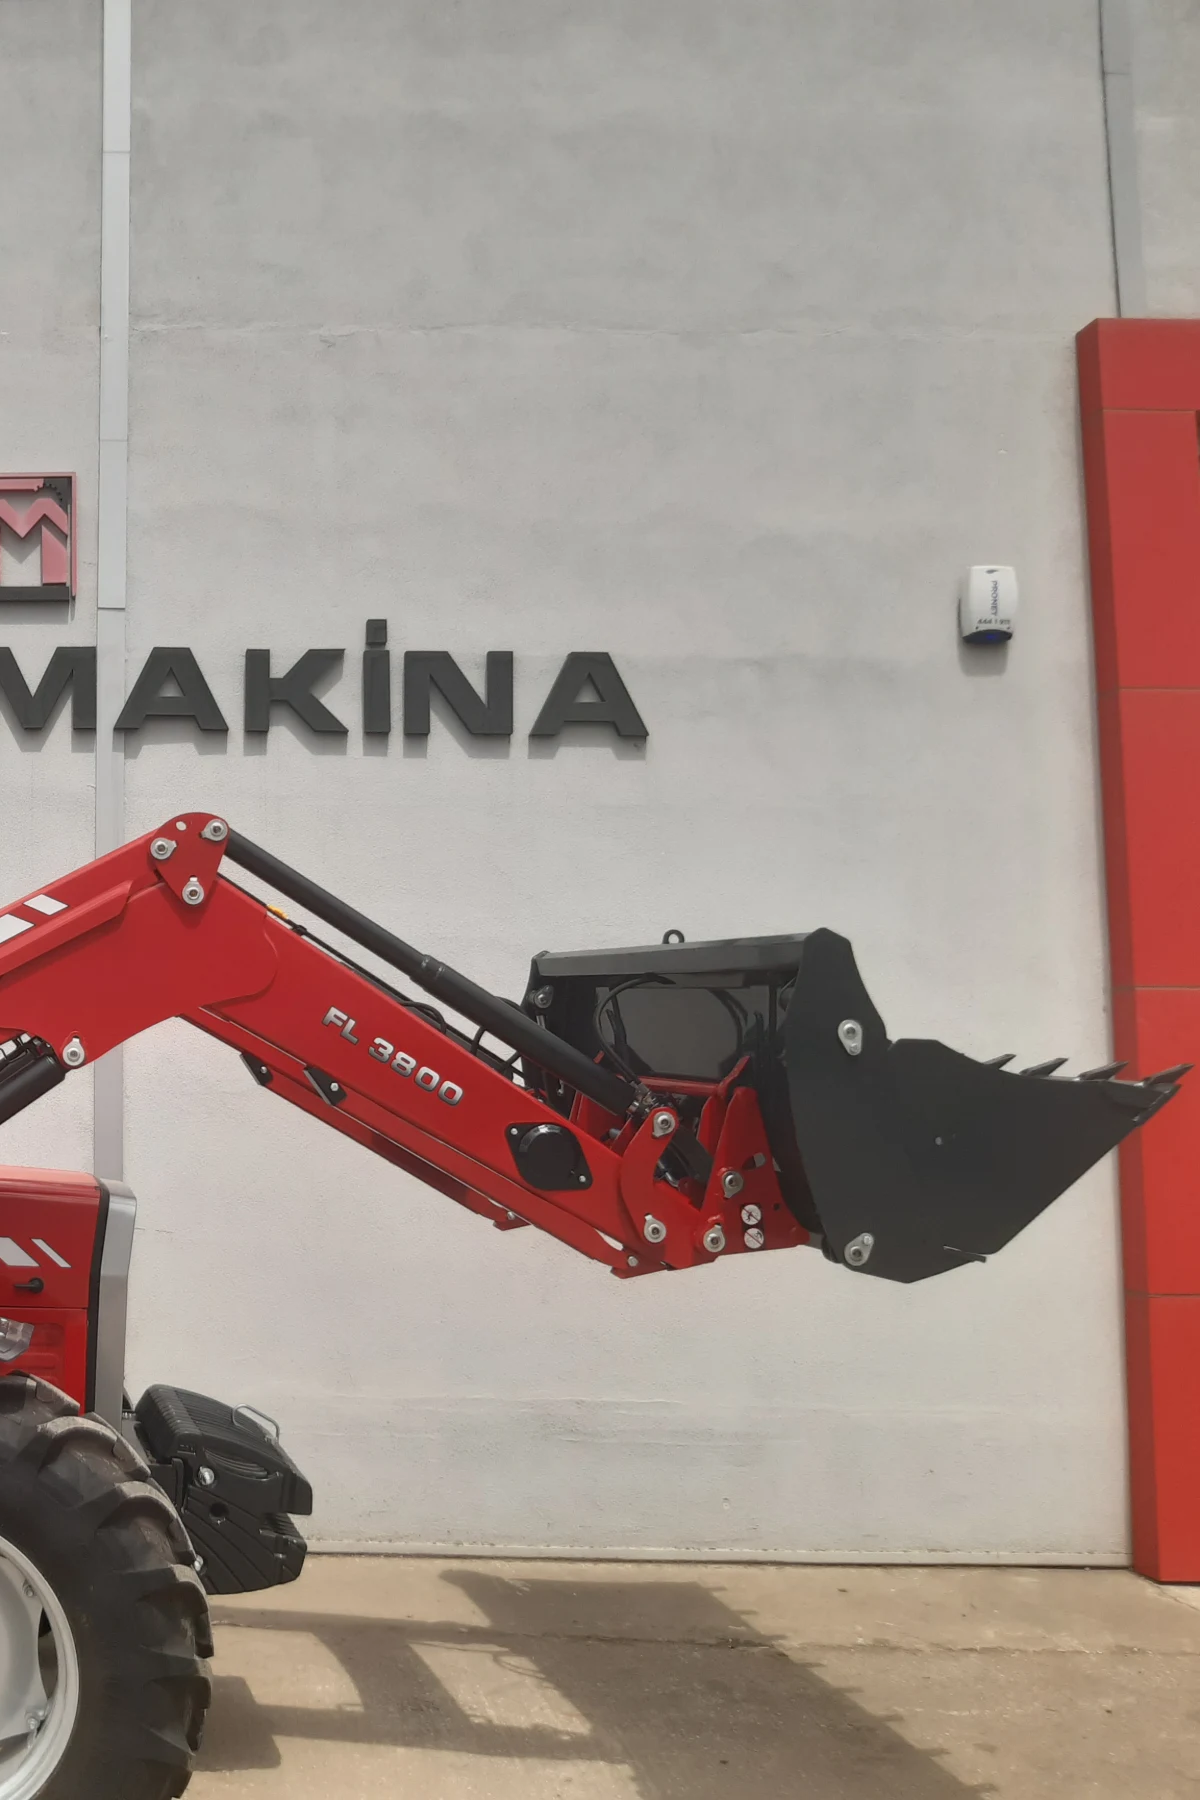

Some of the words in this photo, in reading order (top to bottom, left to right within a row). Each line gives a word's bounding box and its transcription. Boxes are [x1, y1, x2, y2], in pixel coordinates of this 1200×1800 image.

[990, 580, 998, 616] PRONET
[322, 1006, 359, 1045] FL
[368, 1037, 464, 1107] 3800
